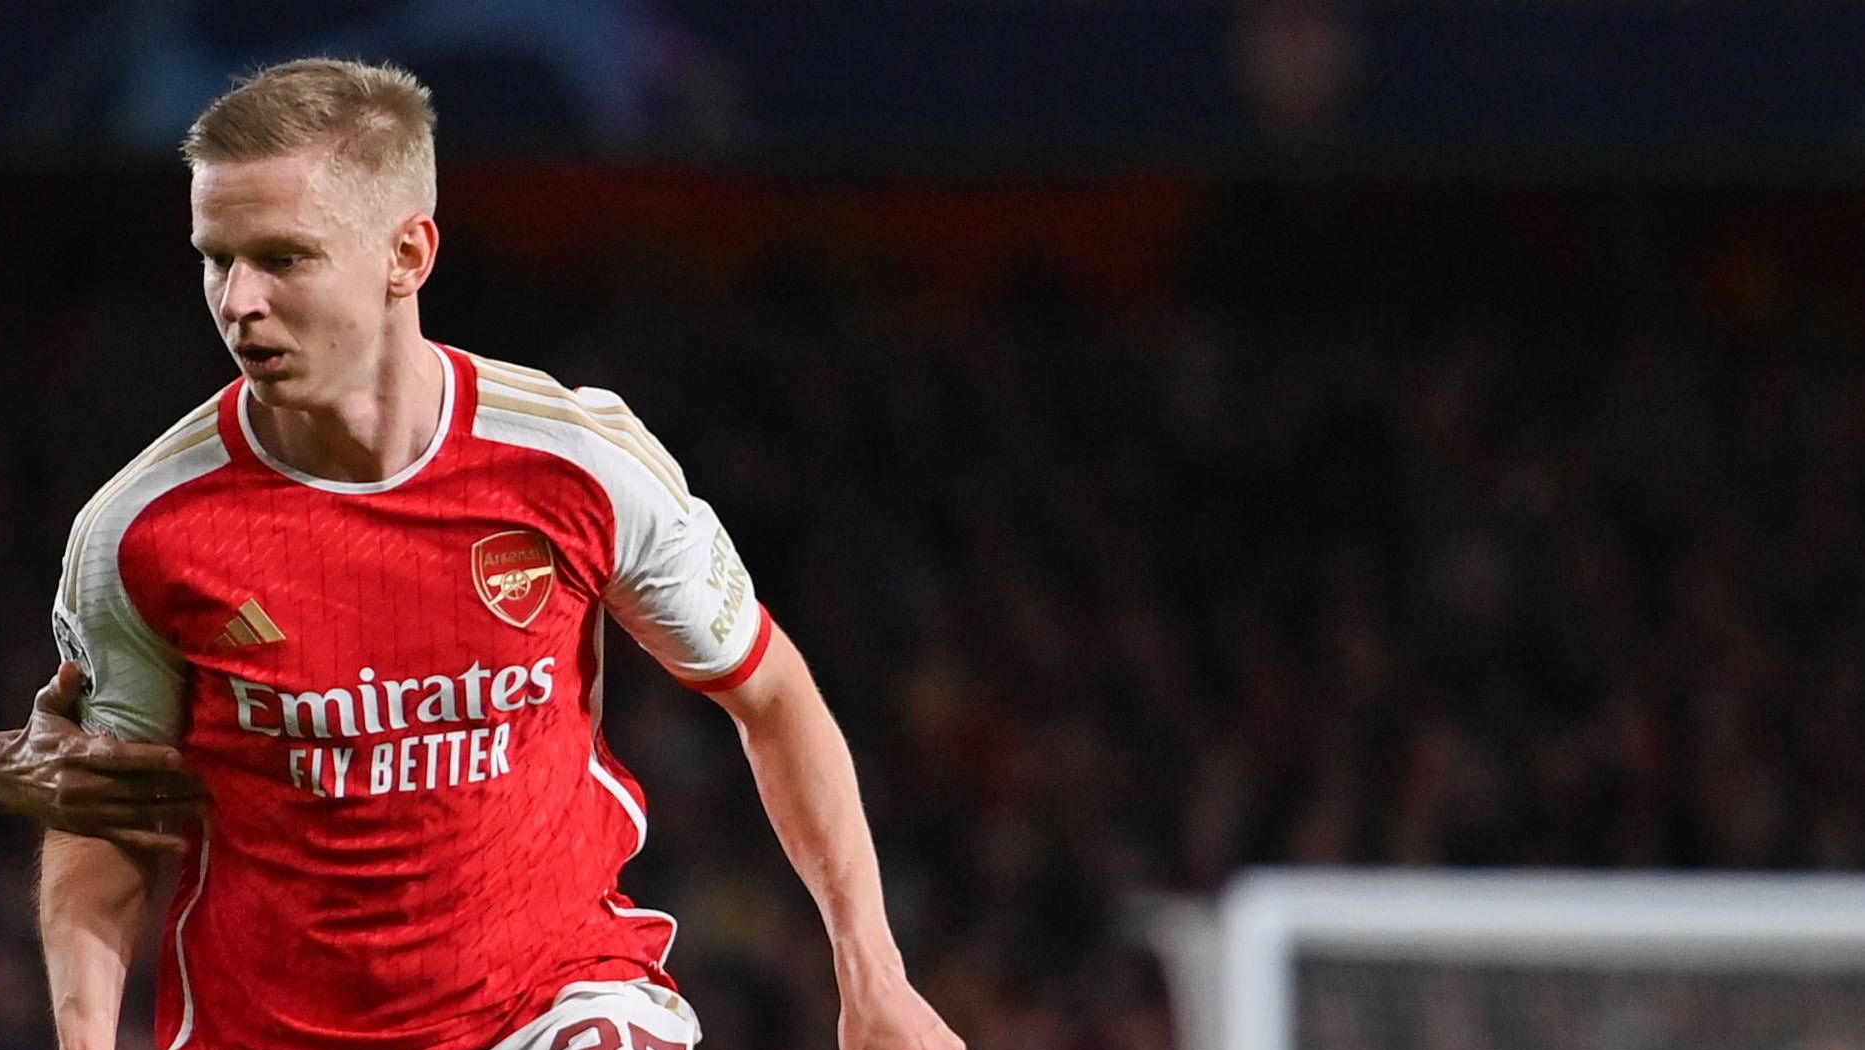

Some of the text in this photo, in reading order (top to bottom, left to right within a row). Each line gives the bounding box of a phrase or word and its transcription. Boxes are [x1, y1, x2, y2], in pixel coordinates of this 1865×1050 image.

[706, 525, 732, 591] VISIT
[710, 555, 746, 645] RWAN
[229, 657, 556, 738] Emirates
[289, 723, 511, 798] FLY BETTER
